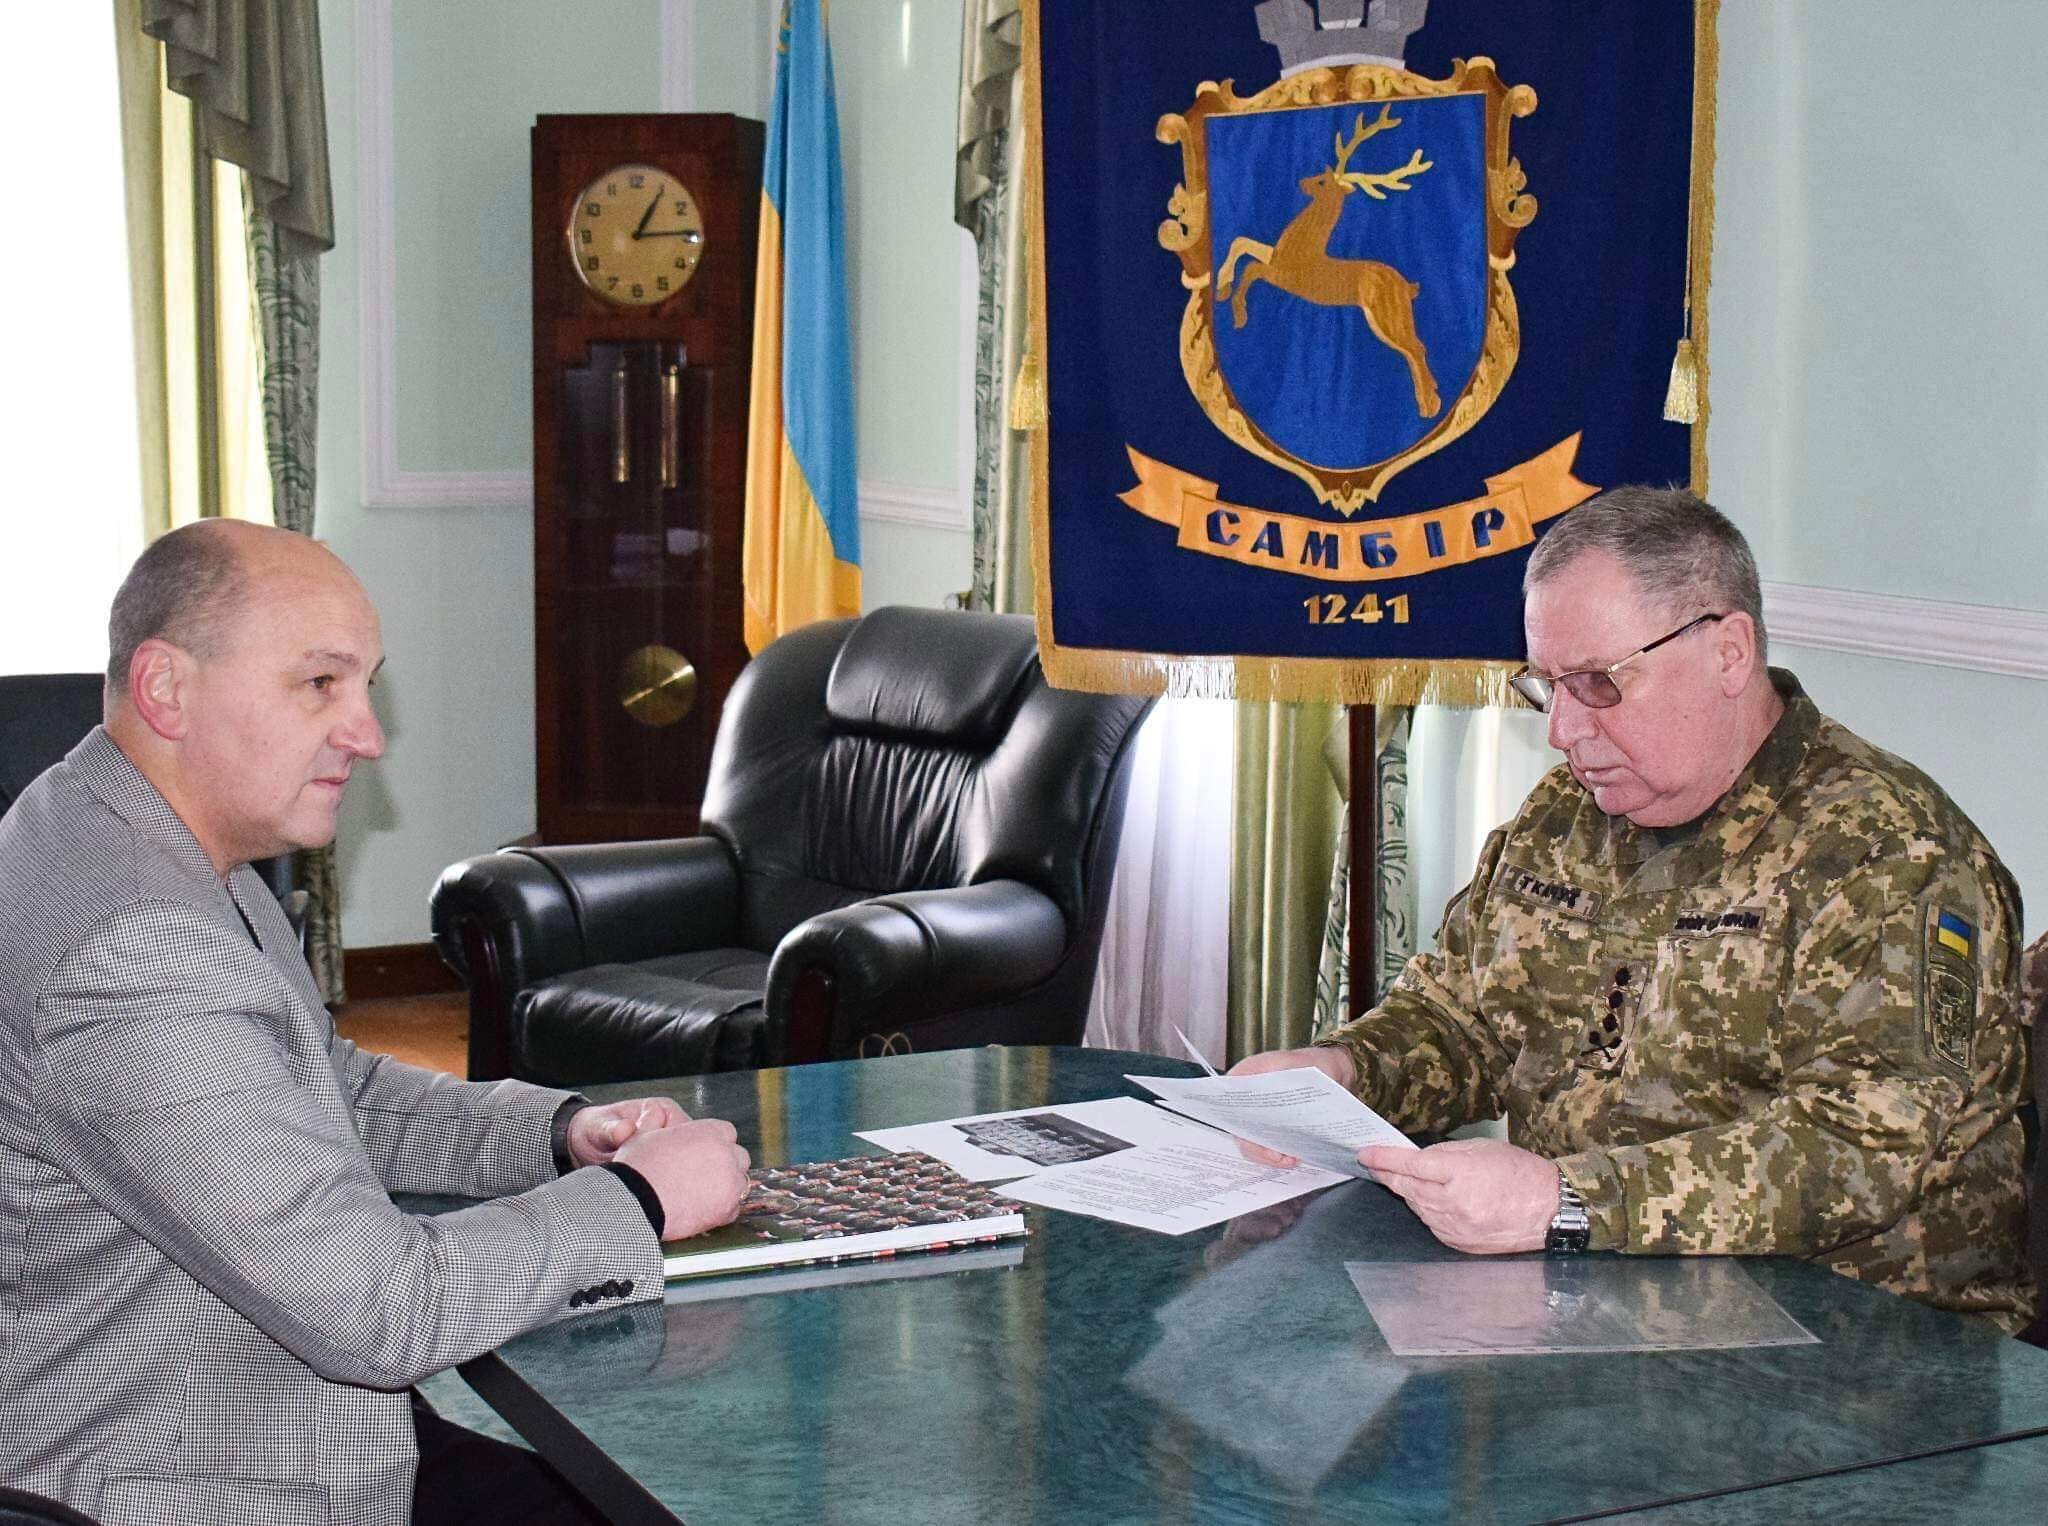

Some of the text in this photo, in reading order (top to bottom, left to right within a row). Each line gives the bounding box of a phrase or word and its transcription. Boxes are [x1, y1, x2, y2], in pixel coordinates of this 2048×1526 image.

[629, 175, 645, 189] 12
[607, 183, 617, 197] 11
[587, 203, 600, 216] 10
[676, 201, 686, 215] 2
[581, 229, 592, 243] 9
[588, 257, 599, 270] 8
[675, 257, 686, 269] 4
[607, 276, 619, 290] 7
[657, 276, 669, 290] 5
[632, 284, 643, 297] 6
[1206, 507, 1506, 570] САМБІР
[1303, 593, 1410, 625] 1241
